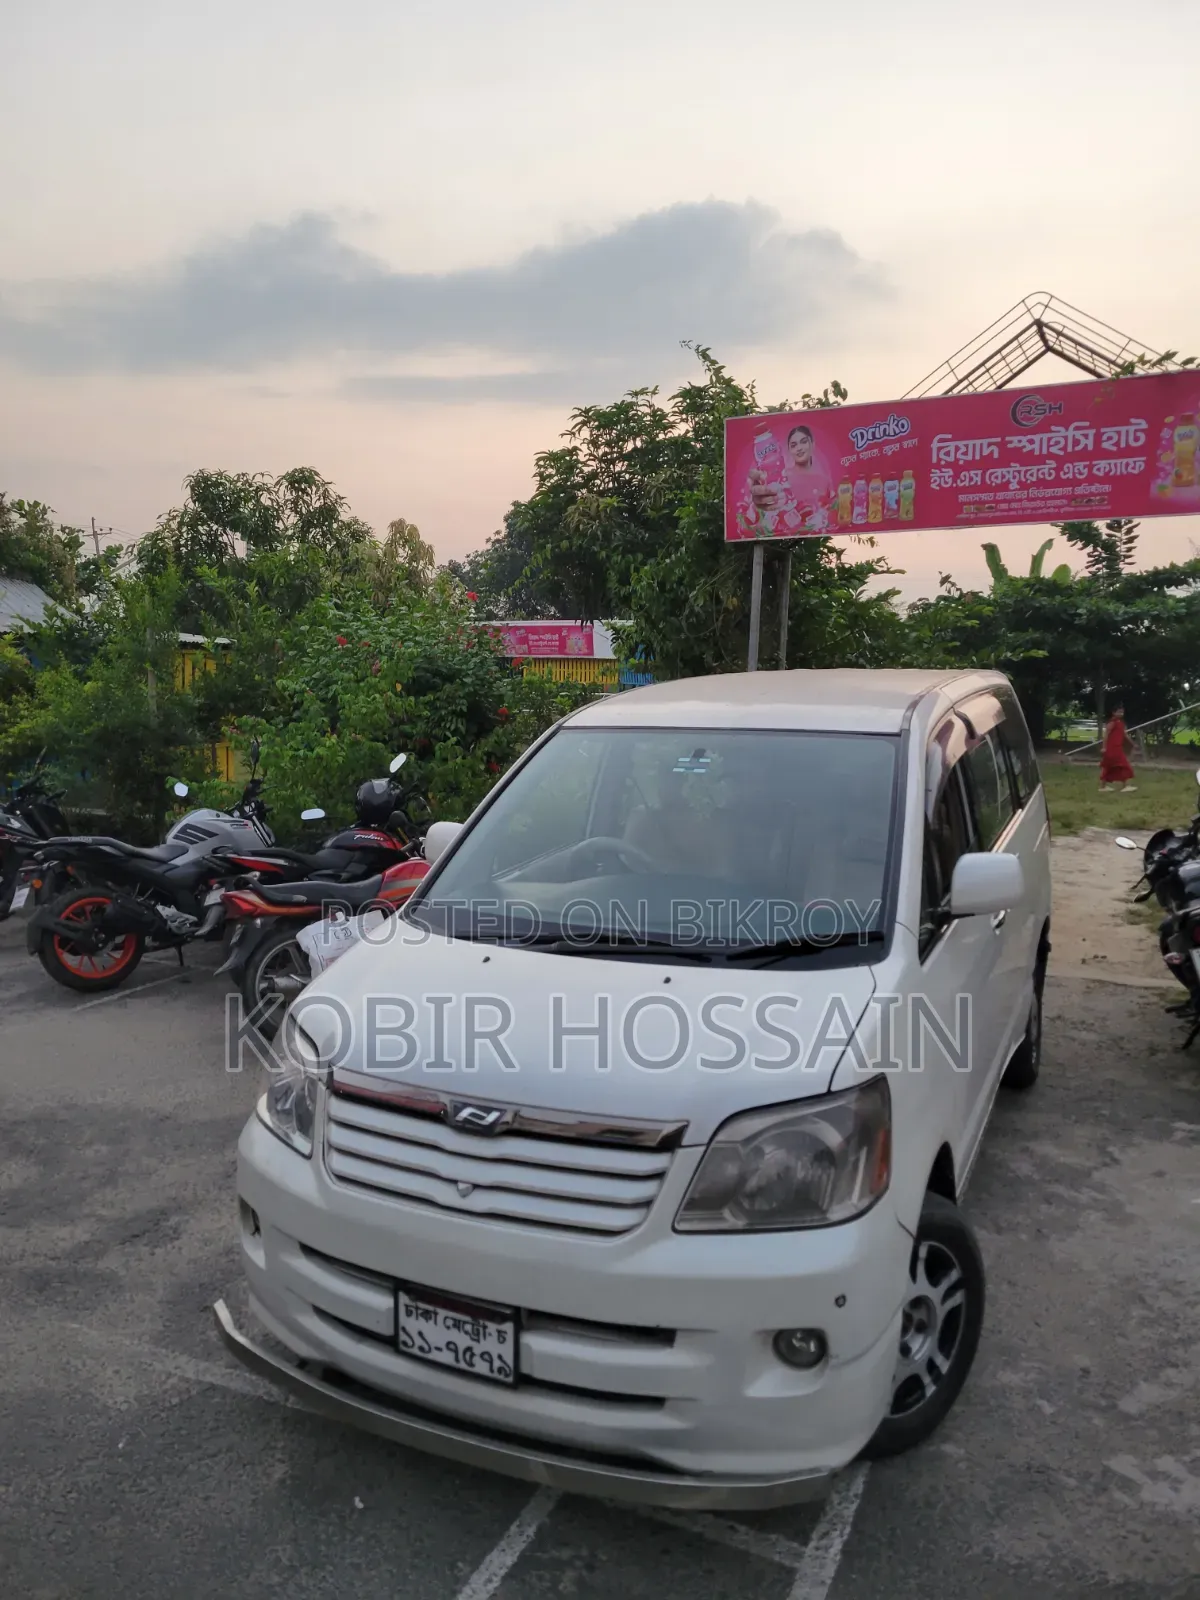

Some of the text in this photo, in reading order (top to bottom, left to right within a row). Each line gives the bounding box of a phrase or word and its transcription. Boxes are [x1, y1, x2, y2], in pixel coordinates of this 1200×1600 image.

[849, 413, 911, 451] Drinko
[931, 418, 1148, 465] রিয়াদ স্পাইসি হাট
[930, 468, 982, 490] ইউ.এস
[985, 460, 1057, 490] রেস্টুরেন্ট
[1060, 461, 1090, 480] এন্ড
[1092, 457, 1147, 477] ক্যাফে
[404, 1302, 439, 1326] ঢাকা
[401, 1325, 512, 1378] ১১-৭৫৭৯
